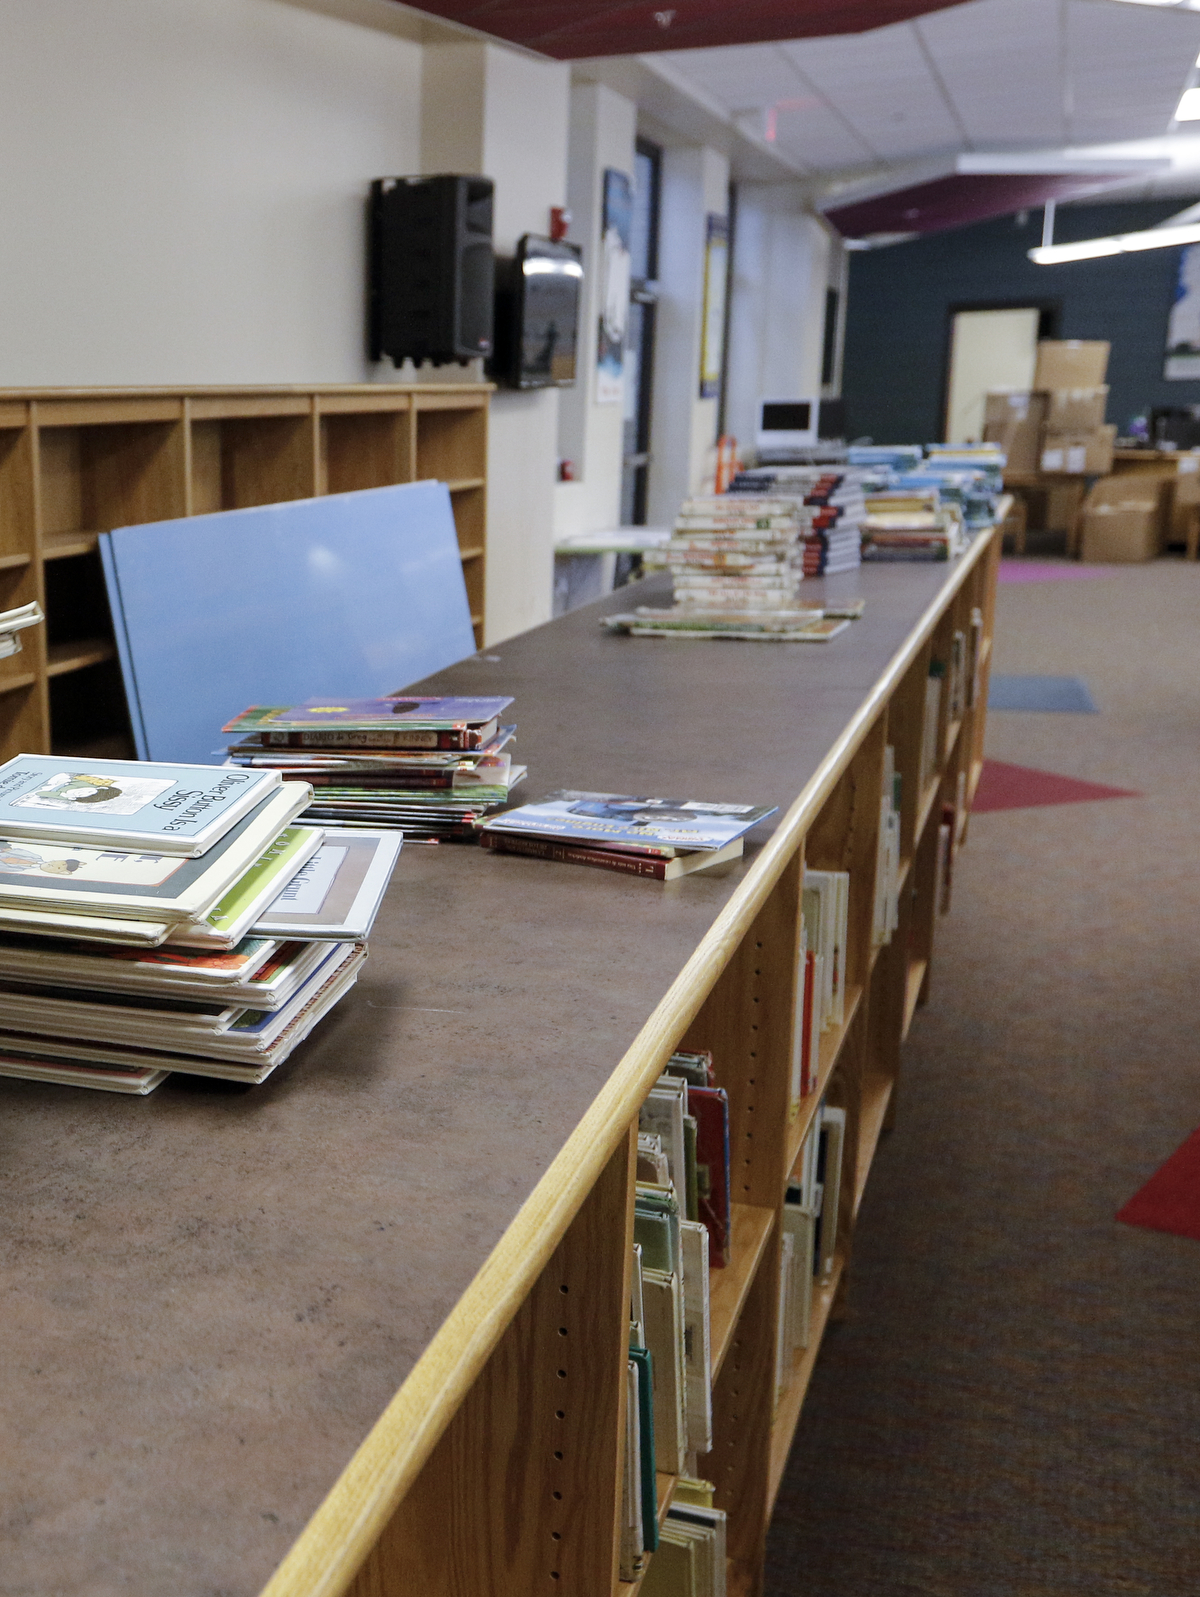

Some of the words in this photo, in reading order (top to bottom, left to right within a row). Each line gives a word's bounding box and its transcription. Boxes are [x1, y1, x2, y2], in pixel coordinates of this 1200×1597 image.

[0, 771, 30, 785] Tomie
[209, 774, 249, 795] Oliver
[154, 789, 203, 811] Sissy
[179, 795, 226, 818] Button
[281, 877, 310, 901] Grunt
